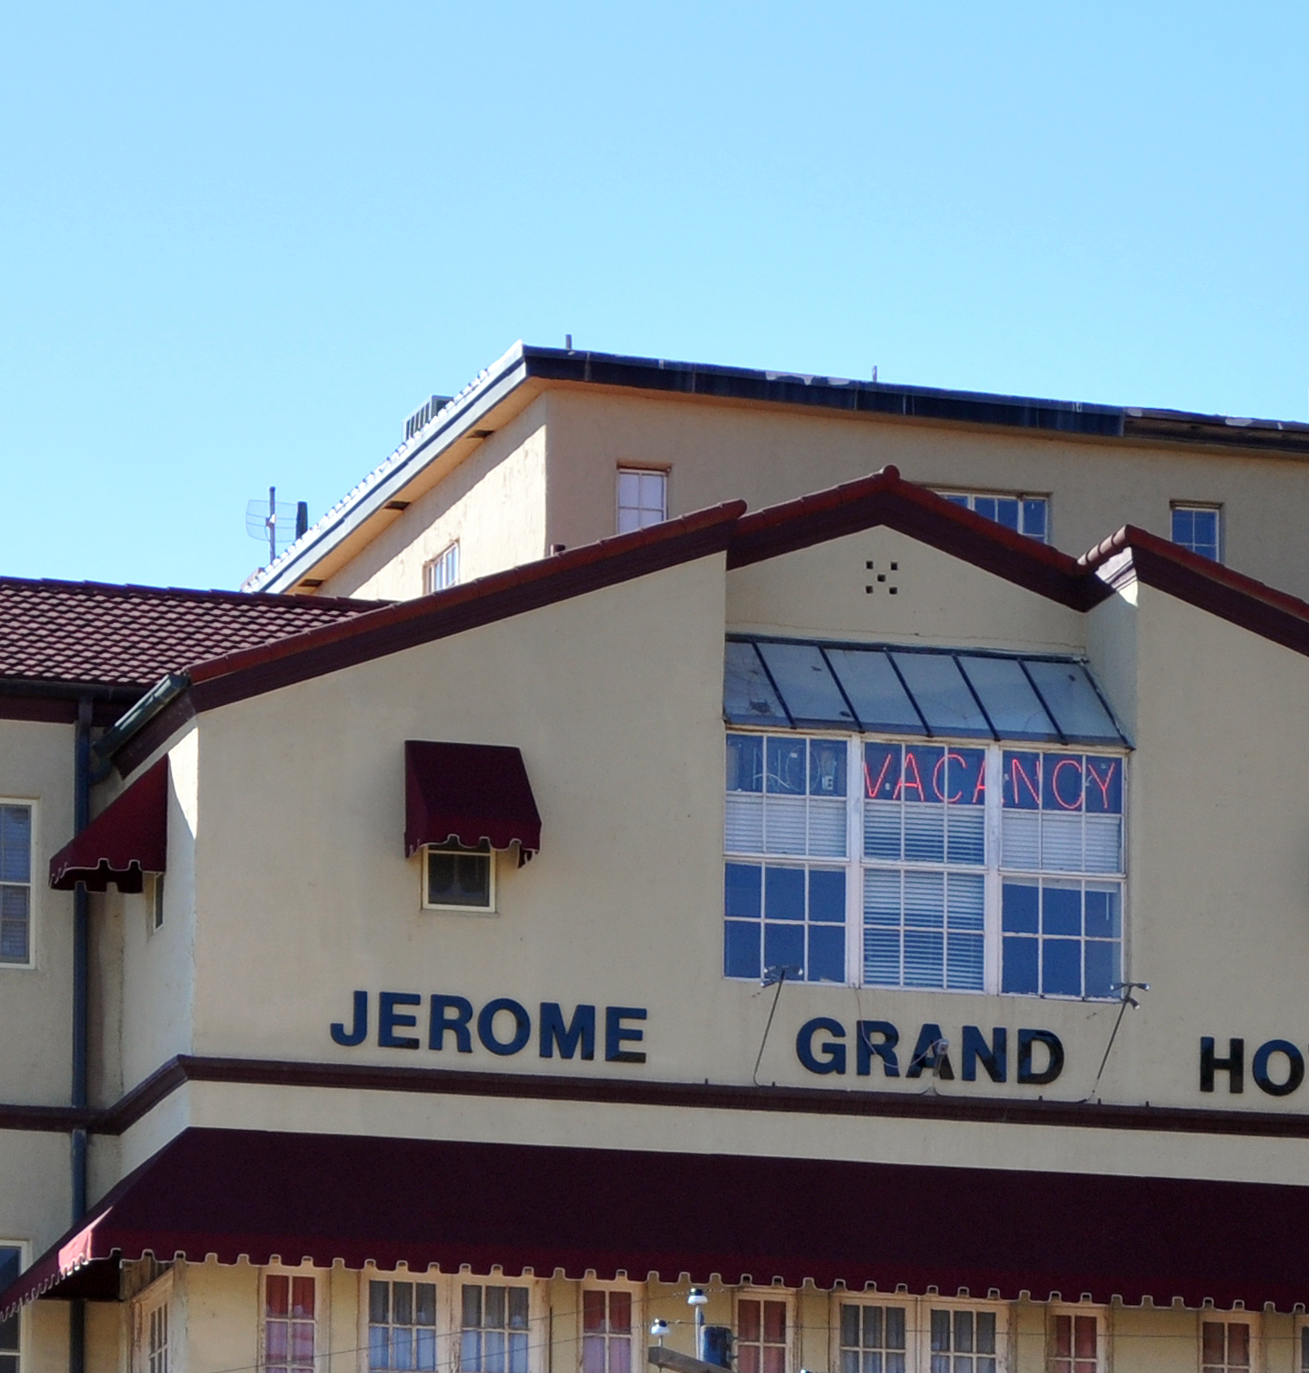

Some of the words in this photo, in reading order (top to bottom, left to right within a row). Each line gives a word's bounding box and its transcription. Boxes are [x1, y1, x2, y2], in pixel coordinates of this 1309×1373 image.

[862, 753, 1115, 810] VACANCY
[330, 990, 648, 1064] JEROME
[796, 1016, 1065, 1085] GRAND
